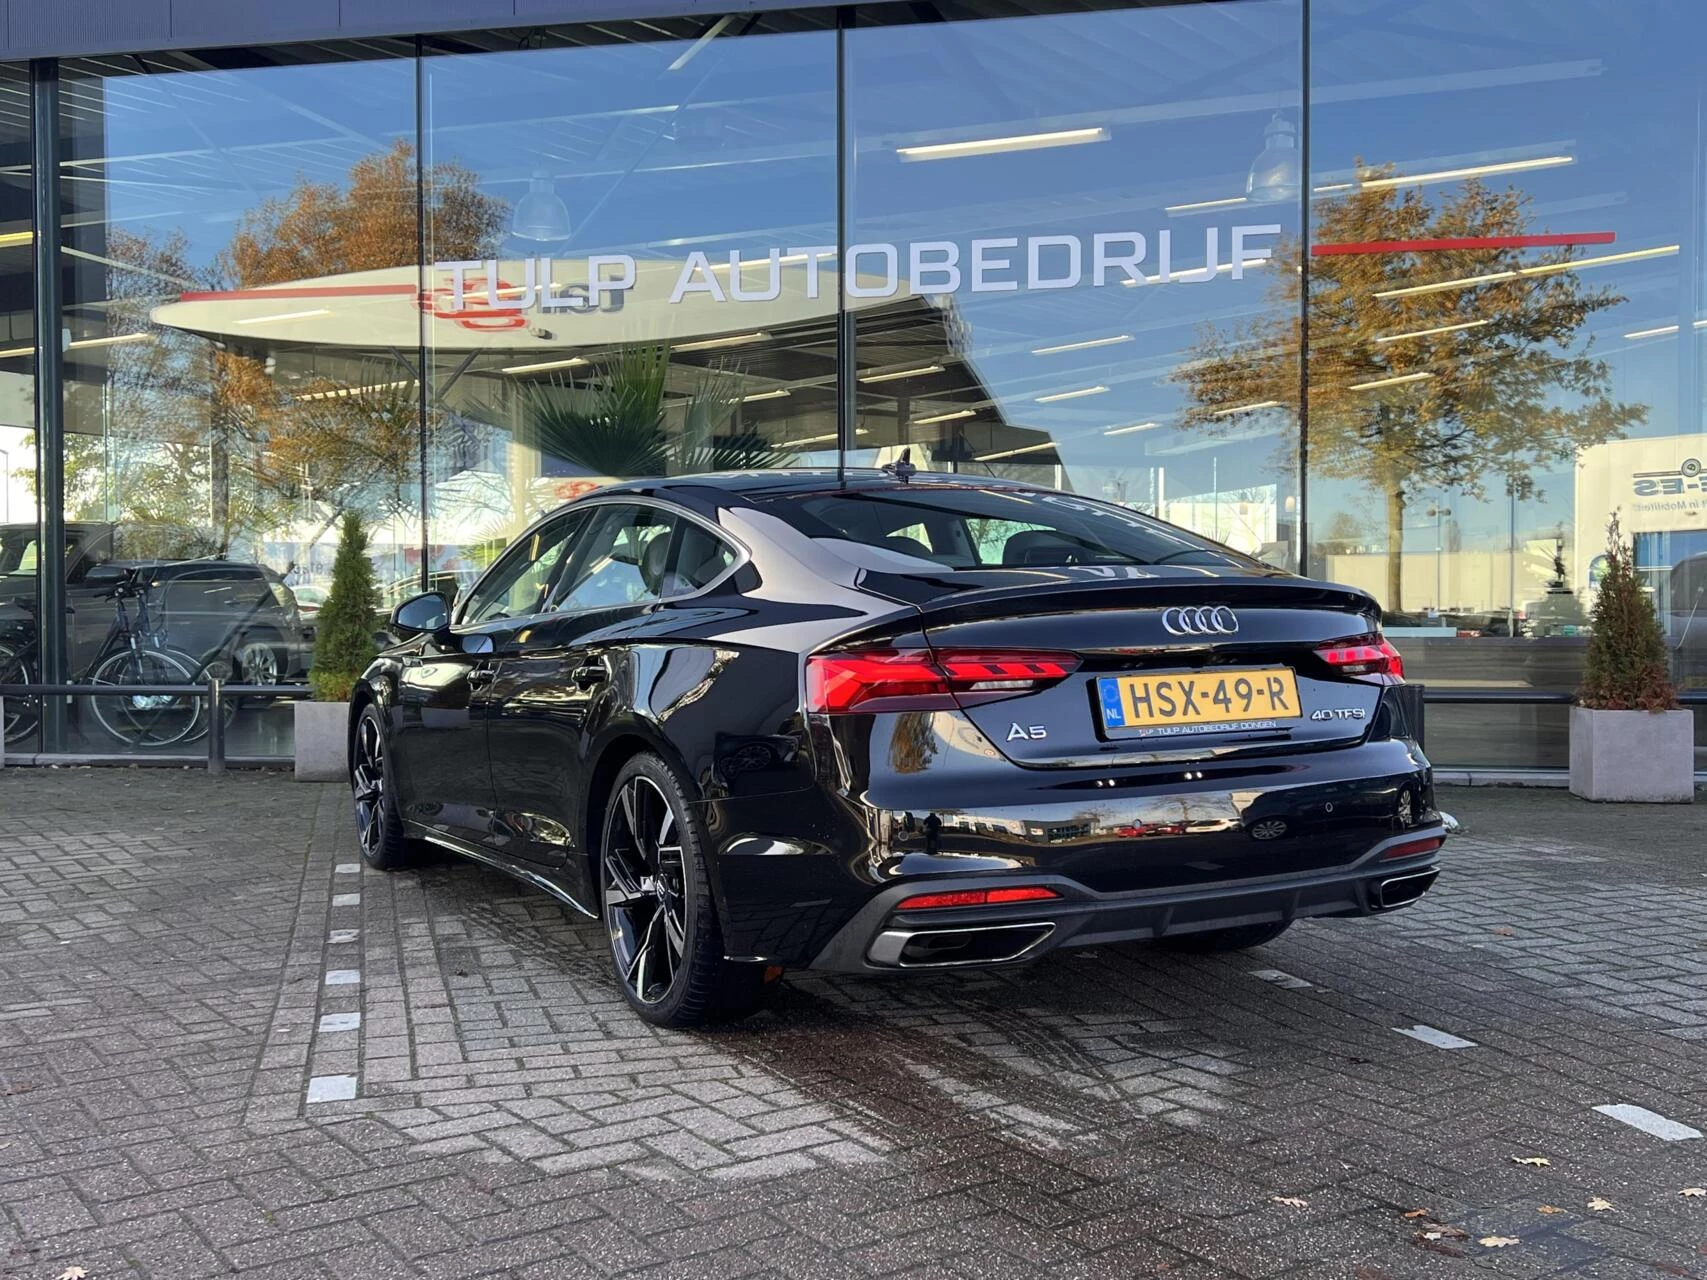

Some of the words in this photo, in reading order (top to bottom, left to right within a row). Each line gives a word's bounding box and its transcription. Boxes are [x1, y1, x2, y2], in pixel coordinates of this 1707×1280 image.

[433, 255, 636, 311] TULP
[669, 224, 1281, 304] AUTOBEDRIJF
[1129, 677, 1289, 719] HSX-49-R
[1106, 708, 1122, 720] NL
[1311, 709, 1333, 720] 40
[1334, 708, 1365, 719] TFSI
[1006, 722, 1046, 741] A5
[1158, 727, 1180, 735] TULP
[1182, 723, 1239, 734] AUTOBEDRIJF
[1241, 720, 1277, 730] DONGEN
